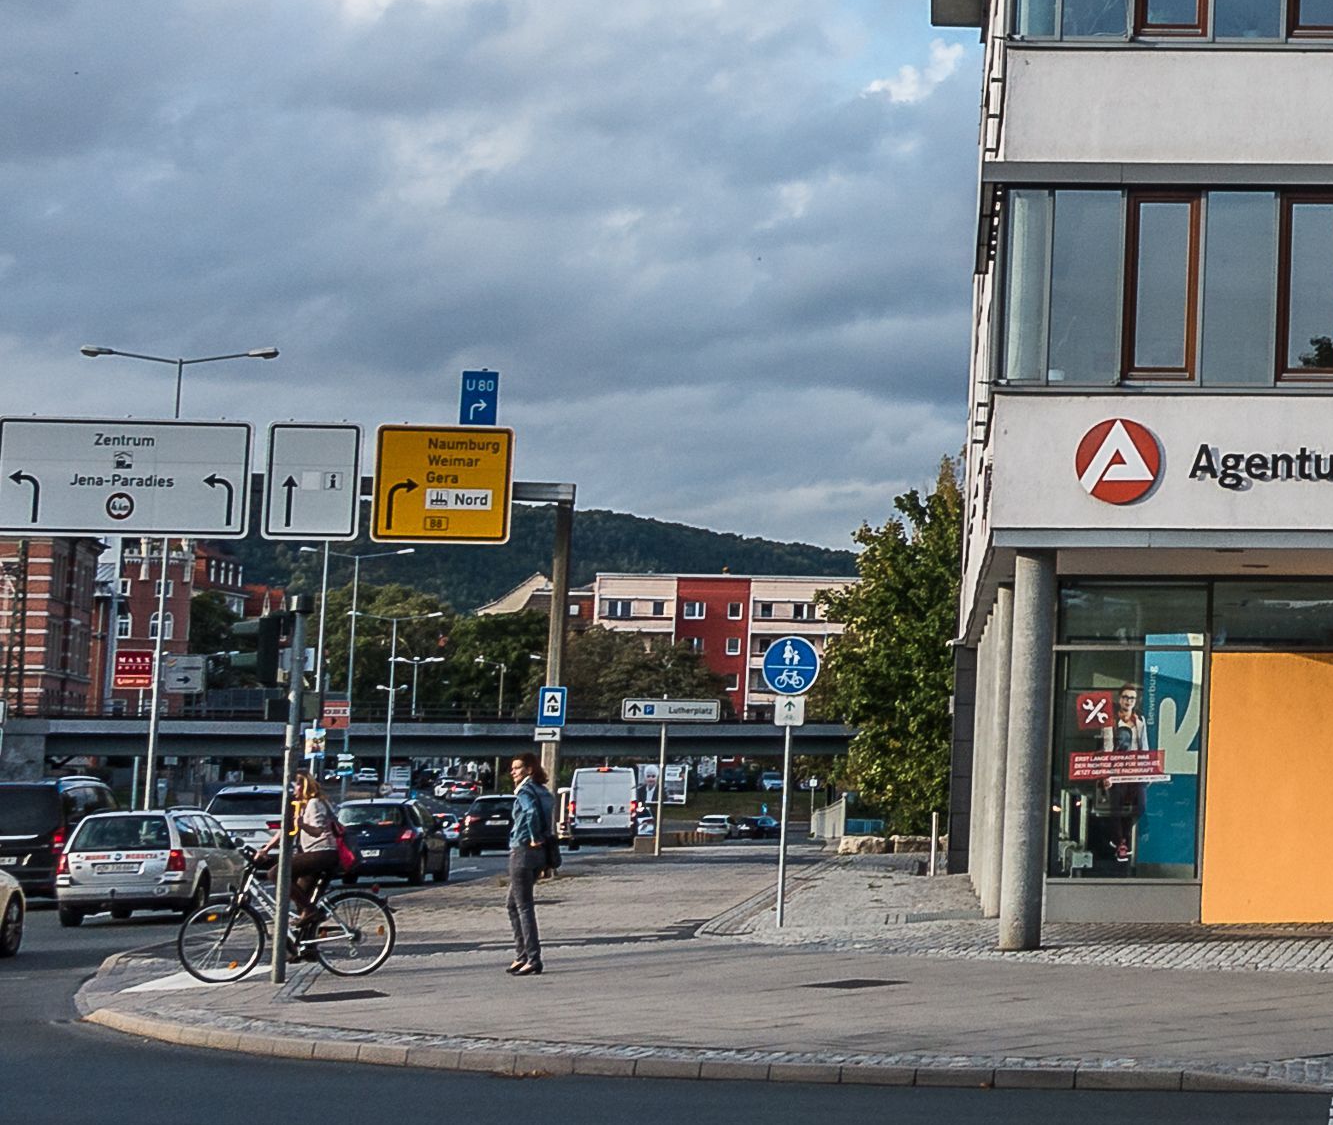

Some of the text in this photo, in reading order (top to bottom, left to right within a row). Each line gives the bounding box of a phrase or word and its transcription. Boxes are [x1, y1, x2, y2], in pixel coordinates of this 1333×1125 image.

[466, 379, 495, 392] U 80
[94, 433, 155, 446] Zentrum
[428, 438, 500, 454] Naumburg
[428, 455, 480, 467] Weimar
[70, 473, 175, 488] Jena-Paradies
[426, 471, 459, 484] Gera
[454, 493, 488, 506] Nord
[1147, 665, 1159, 725] Bewerbung
[668, 706, 713, 716] Lutherplatz
